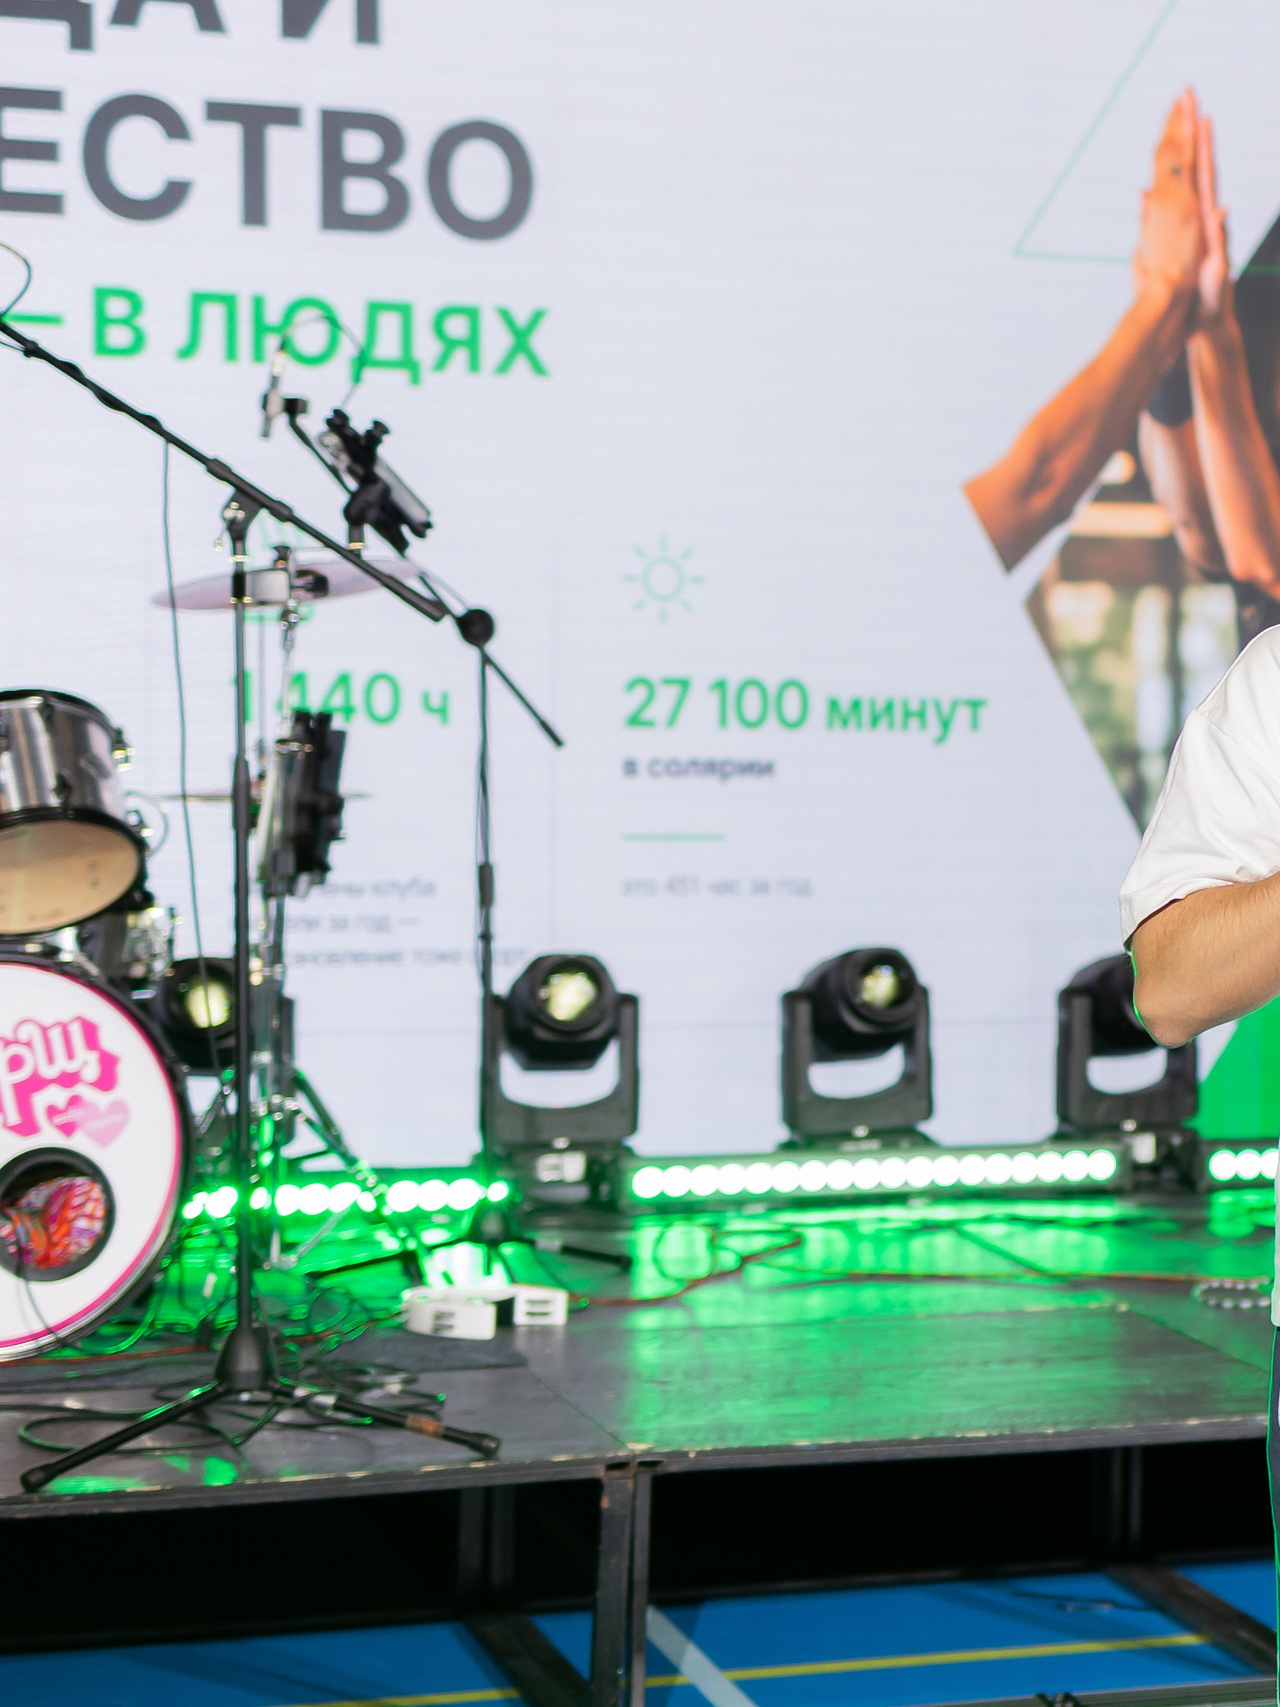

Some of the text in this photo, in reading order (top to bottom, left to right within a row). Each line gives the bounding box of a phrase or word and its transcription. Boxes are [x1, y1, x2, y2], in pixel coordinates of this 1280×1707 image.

[624, 677, 989, 745] 27 100 минут
